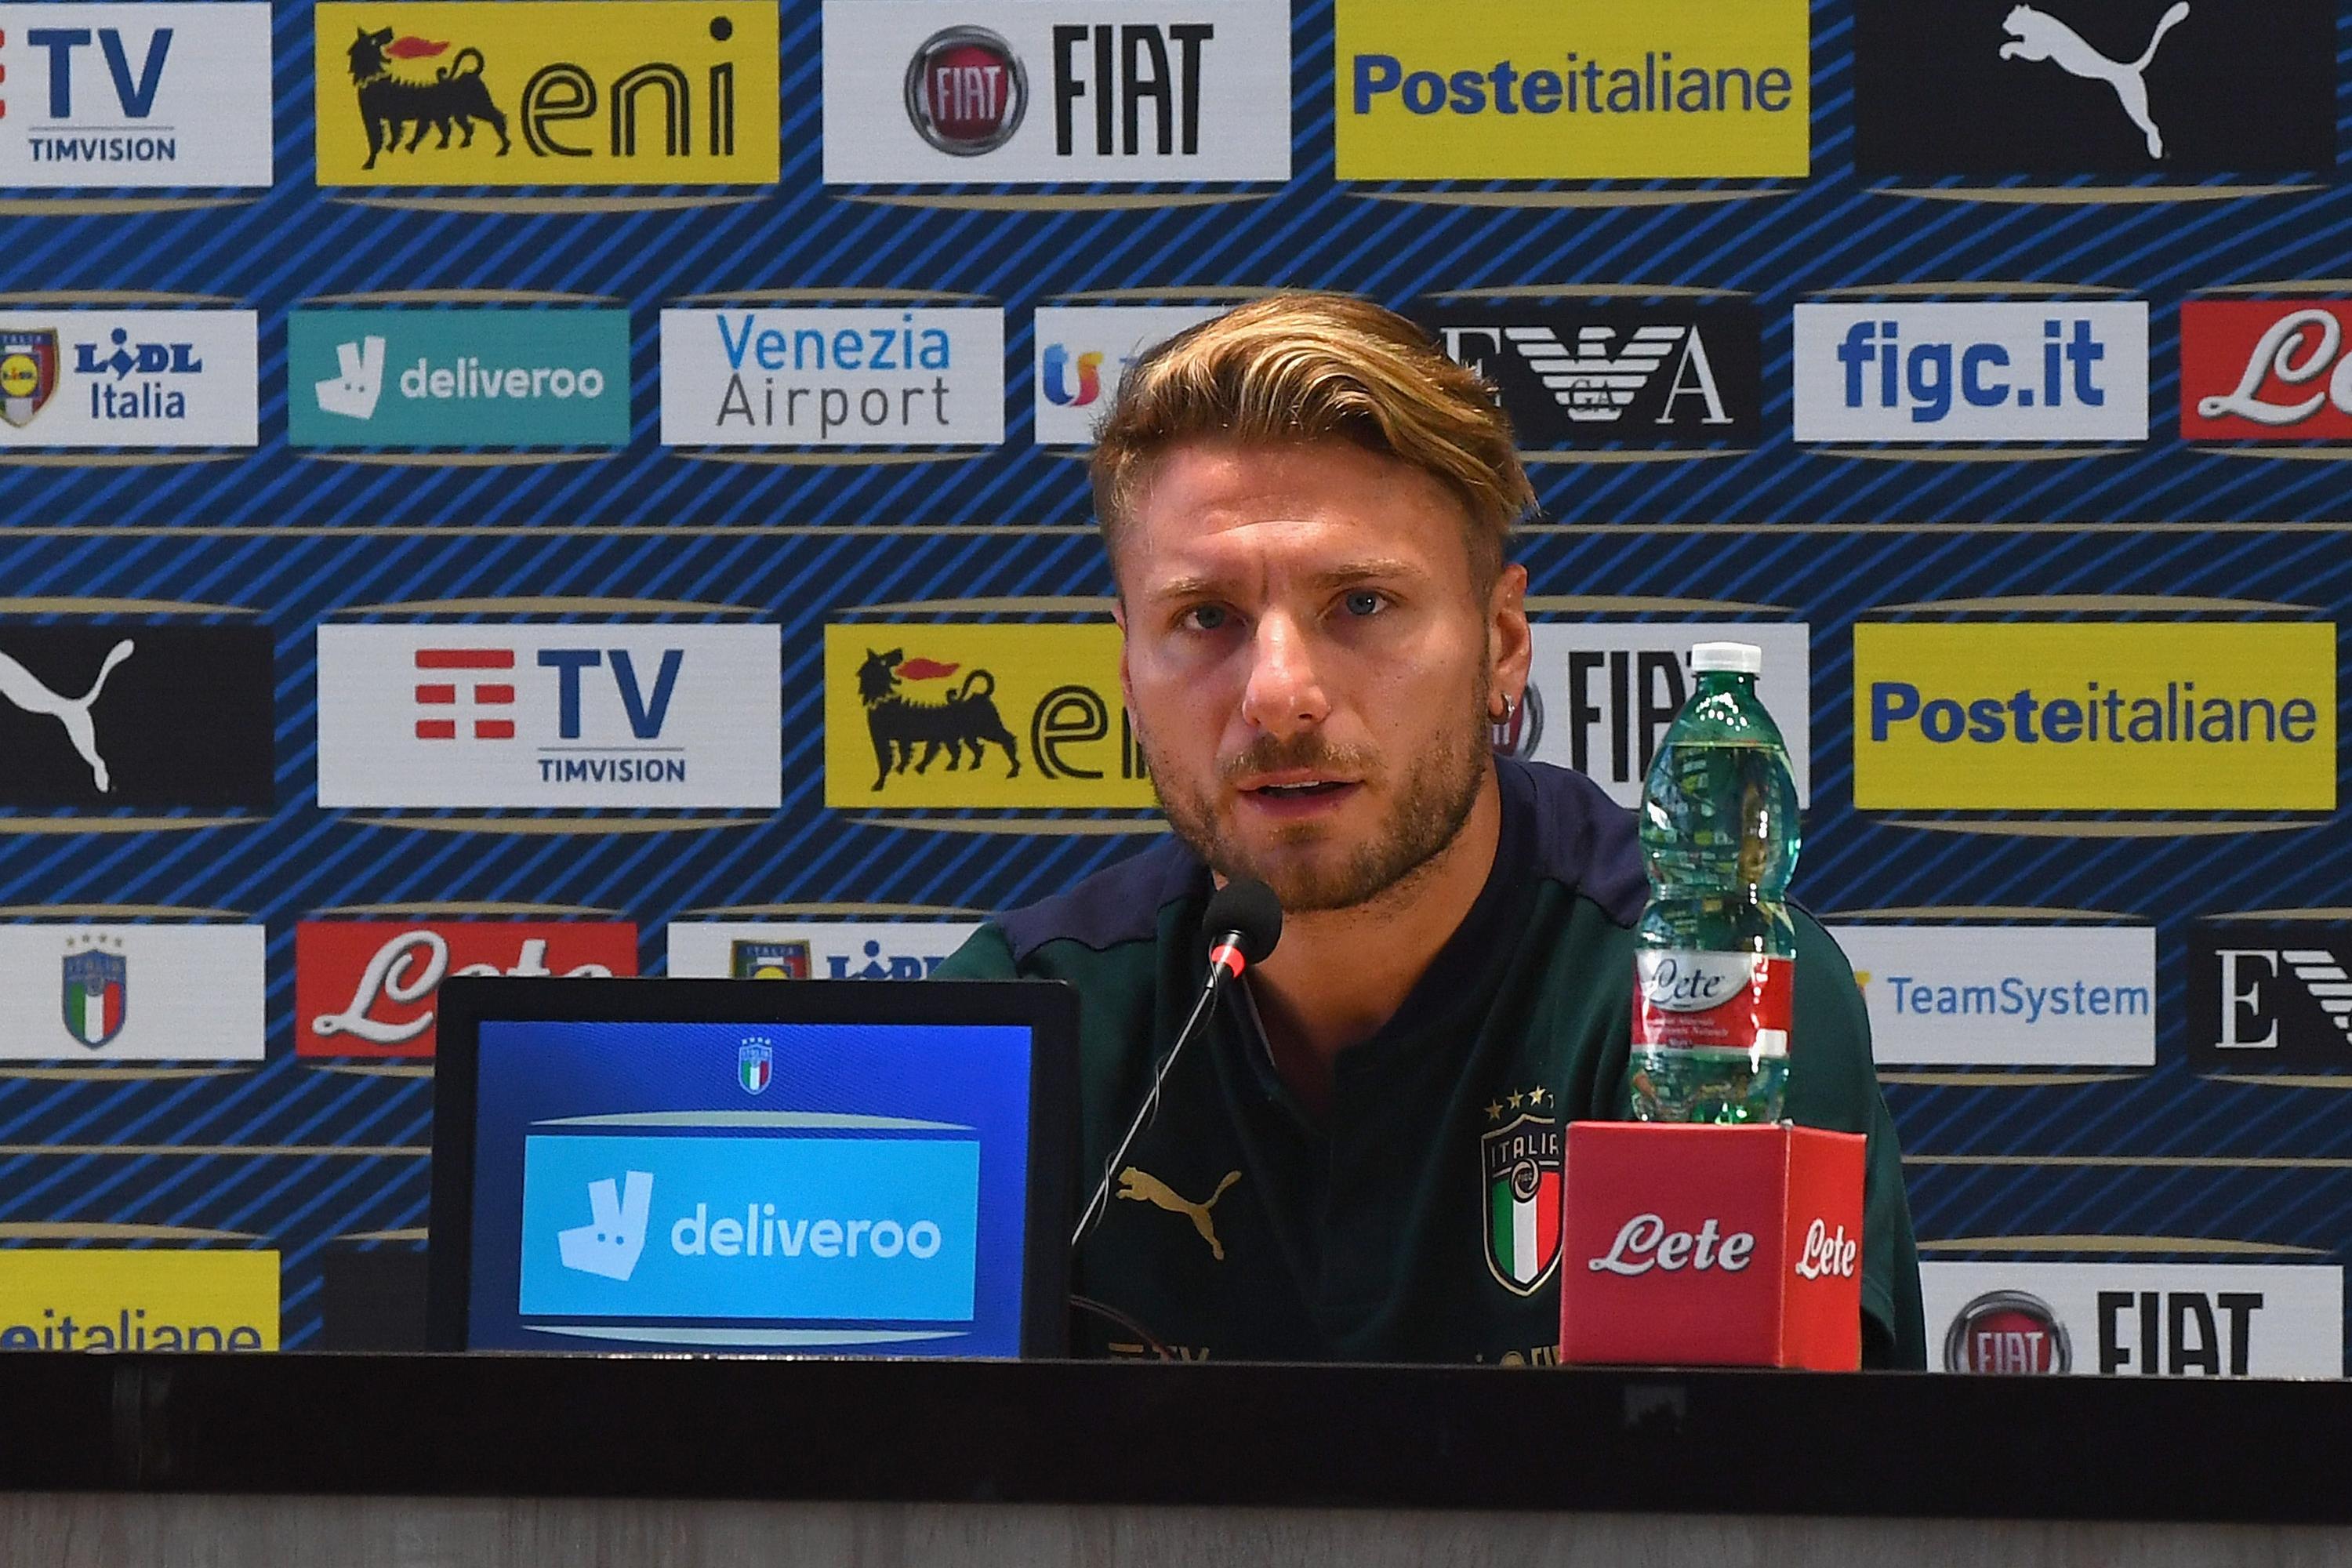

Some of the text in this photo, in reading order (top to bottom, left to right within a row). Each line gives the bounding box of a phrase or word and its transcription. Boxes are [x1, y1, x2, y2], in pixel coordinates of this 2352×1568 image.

[27, 28, 174, 118] TV
[521, 16, 735, 158] eni
[935, 65, 1002, 120] FIAT
[1053, 23, 1214, 156] FIAT
[1352, 51, 1792, 114] Posteitaliane
[29, 138, 176, 162] TIMVISION
[716, 314, 950, 371] Venezia
[1837, 319, 2104, 423] figc.it
[91, 382, 185, 419] Italia
[400, 357, 604, 398] deliveroo
[716, 373, 950, 439] Airport
[537, 649, 684, 739] TV
[1569, 651, 1692, 782] FIA
[1871, 681, 2316, 742] Posteitaliane
[538, 759, 684, 782] TIMVISION
[1647, 958, 1721, 1004] Lete
[1887, 978, 2149, 1022] TeamSystem
[1492, 1133, 1559, 1167] ITALIA
[671, 1204, 942, 1259] deliveroo
[1588, 1214, 1755, 1275] Lete
[1795, 1218, 1857, 1279] Lete
[1976, 1332, 2044, 1374] FIAT
[2097, 1292, 2264, 1375] FIAT
